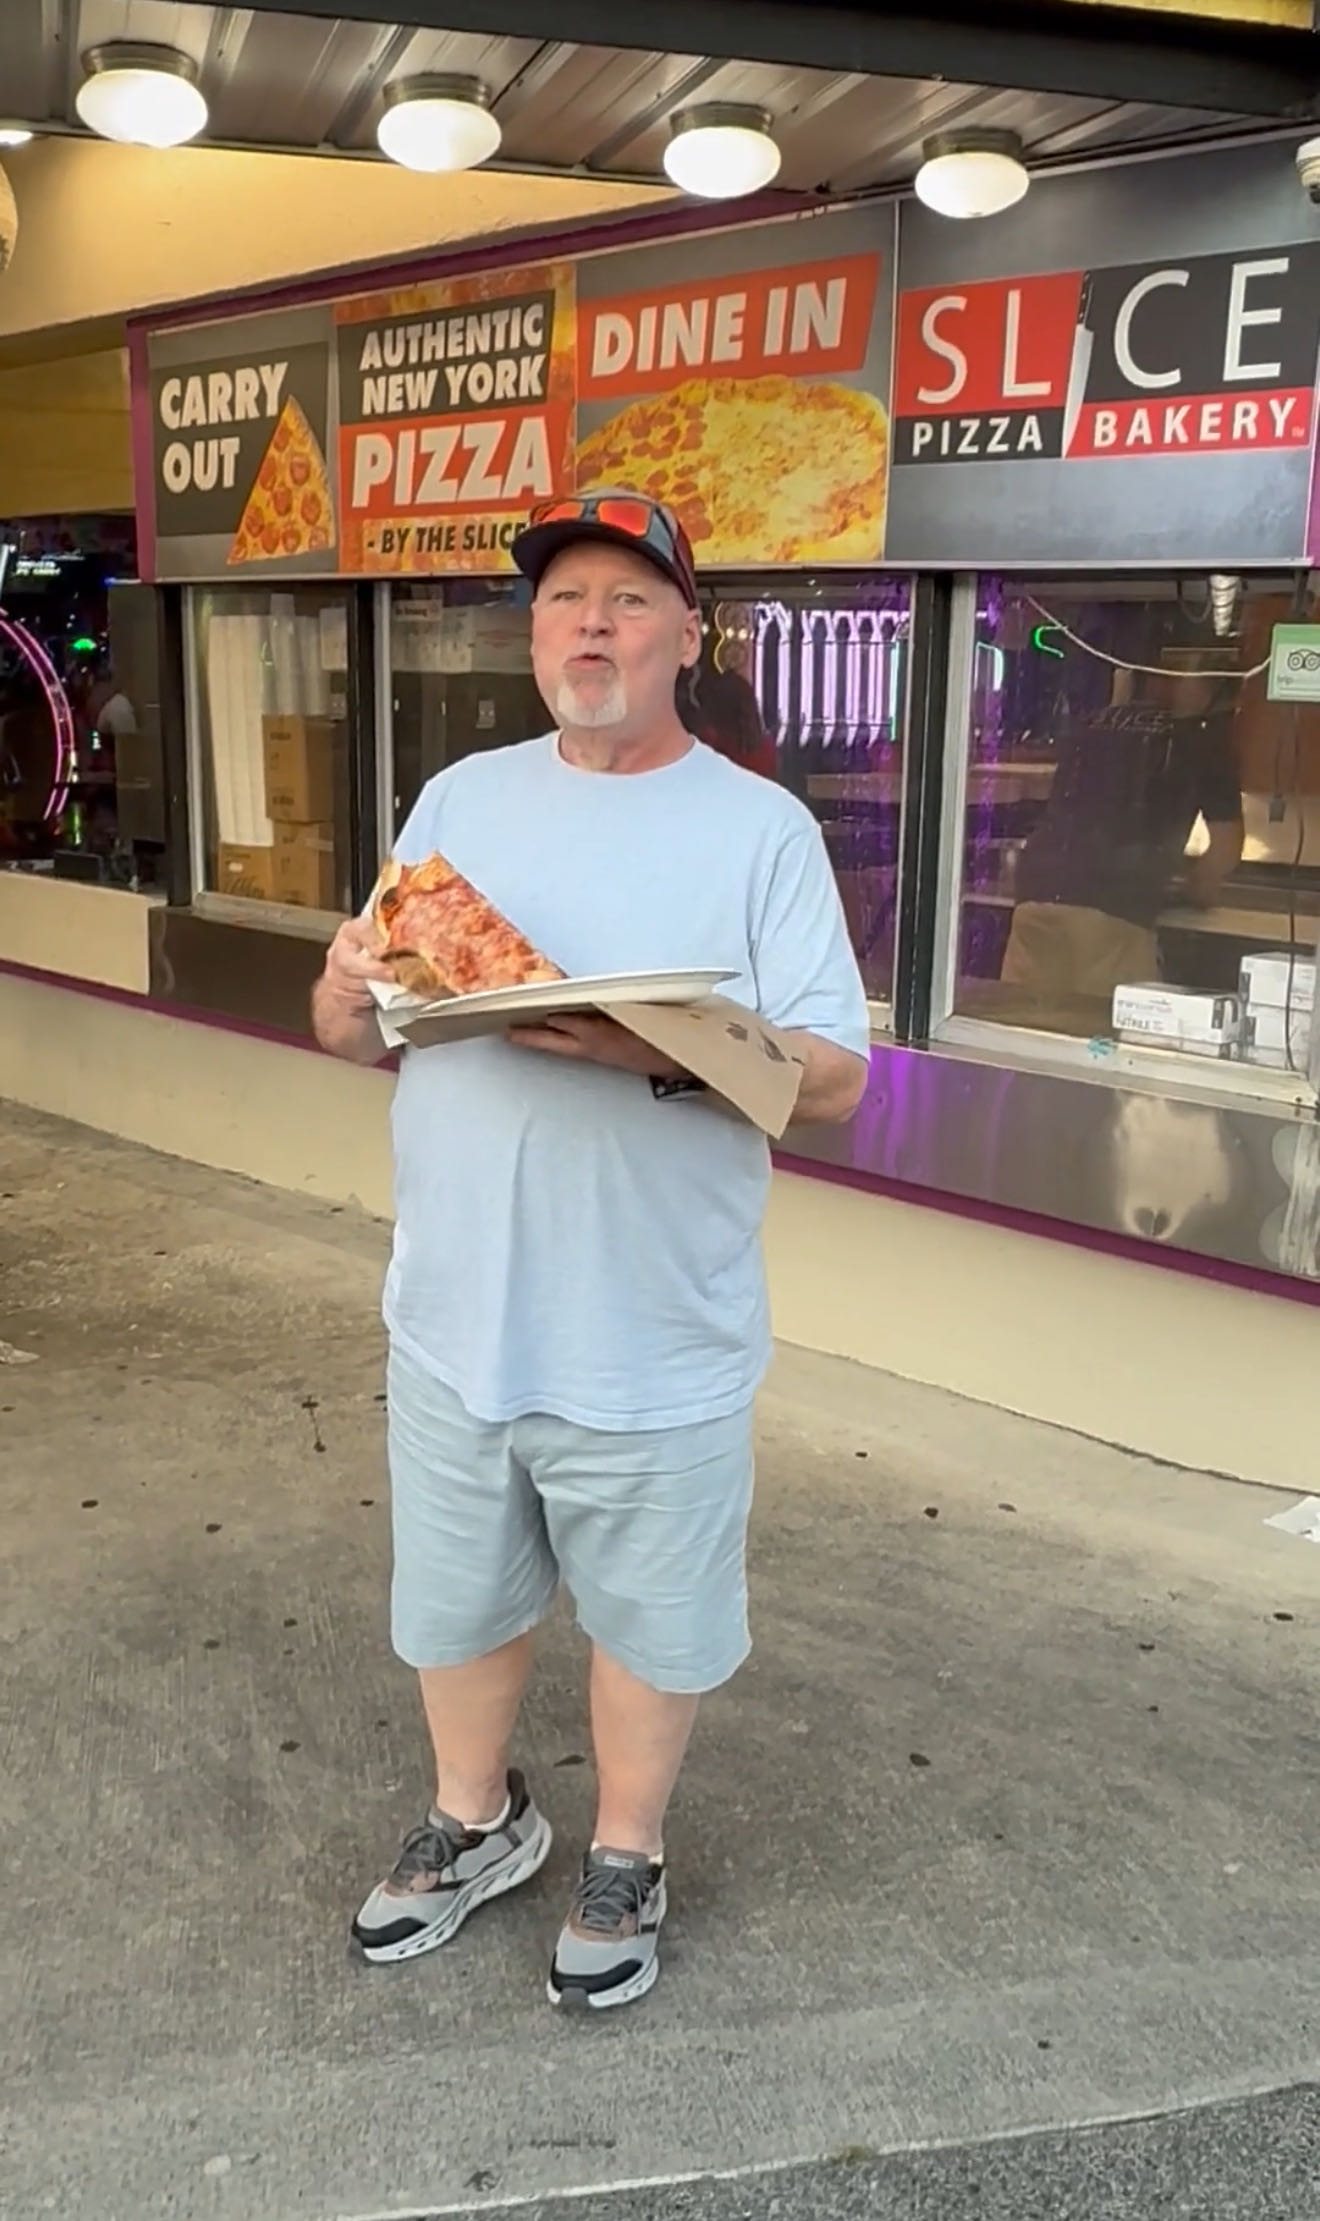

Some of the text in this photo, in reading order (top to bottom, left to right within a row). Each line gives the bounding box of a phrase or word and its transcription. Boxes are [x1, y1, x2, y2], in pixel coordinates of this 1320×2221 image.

[359, 304, 544, 371] AUTHENTIC
[592, 278, 847, 377] DINE IN
[160, 362, 288, 430] CARRY
[362, 354, 546, 415] NEW YORK
[912, 397, 1297, 457] PIZZA BAKERY
[163, 437, 240, 493] OUT
[352, 416, 553, 507] PIZZA
[381, 527, 411, 553] BY
[416, 525, 455, 553] THE
